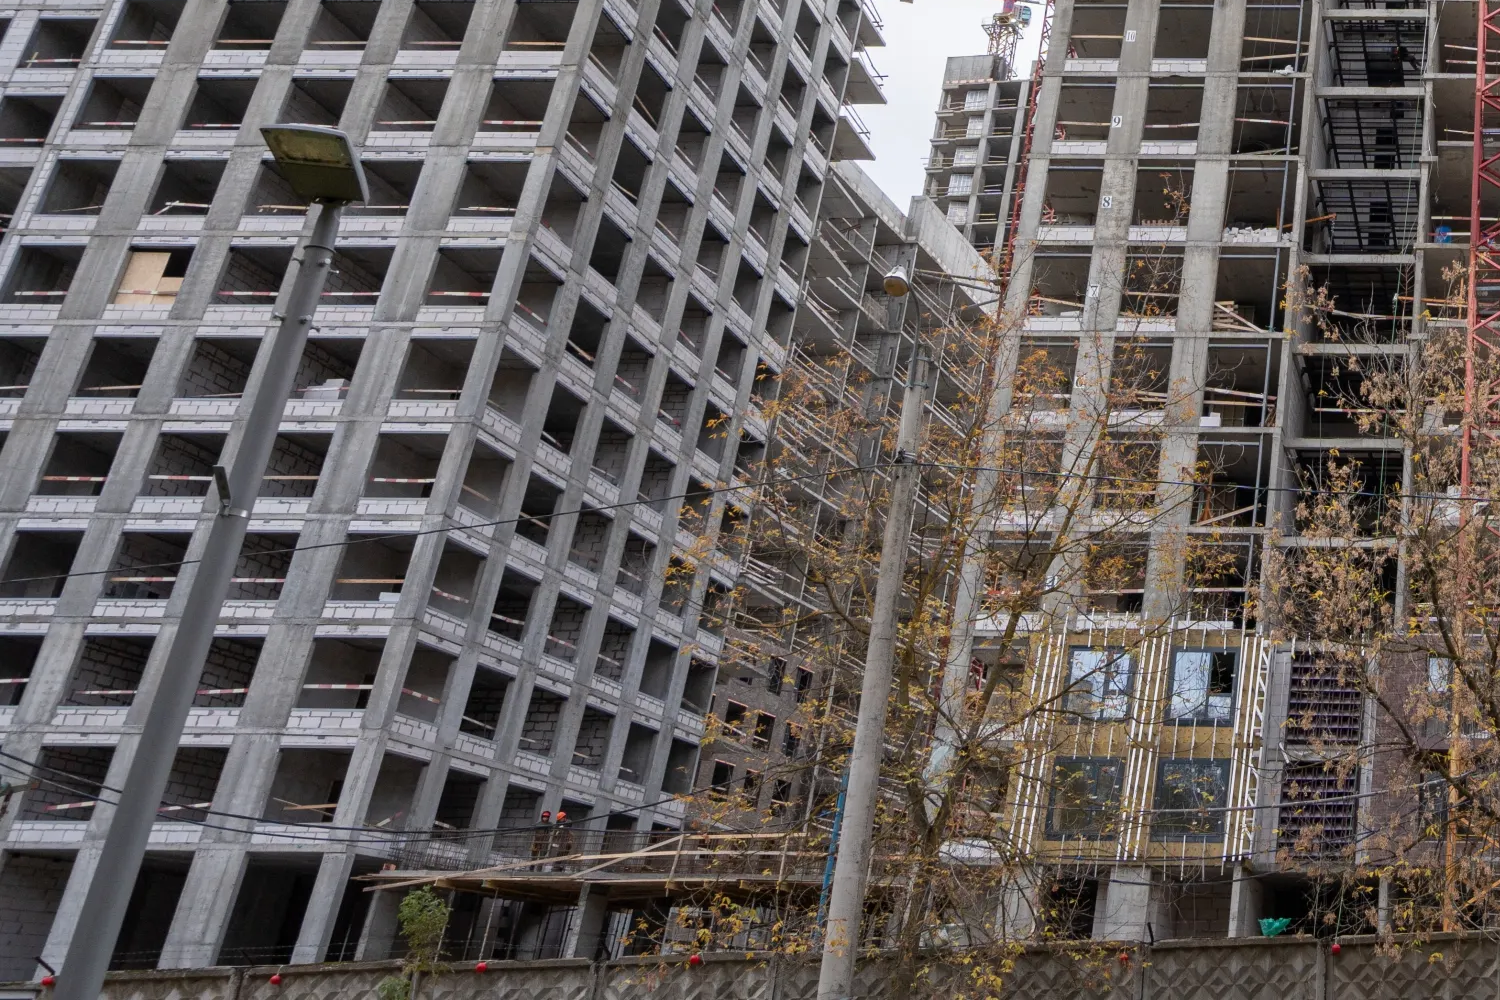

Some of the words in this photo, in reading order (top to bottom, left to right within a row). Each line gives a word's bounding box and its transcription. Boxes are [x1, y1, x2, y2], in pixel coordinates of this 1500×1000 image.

[1126, 31, 1136, 41] 10
[1113, 116, 1121, 127] 9
[1102, 196, 1111, 207] 8
[1090, 285, 1099, 297] 7
